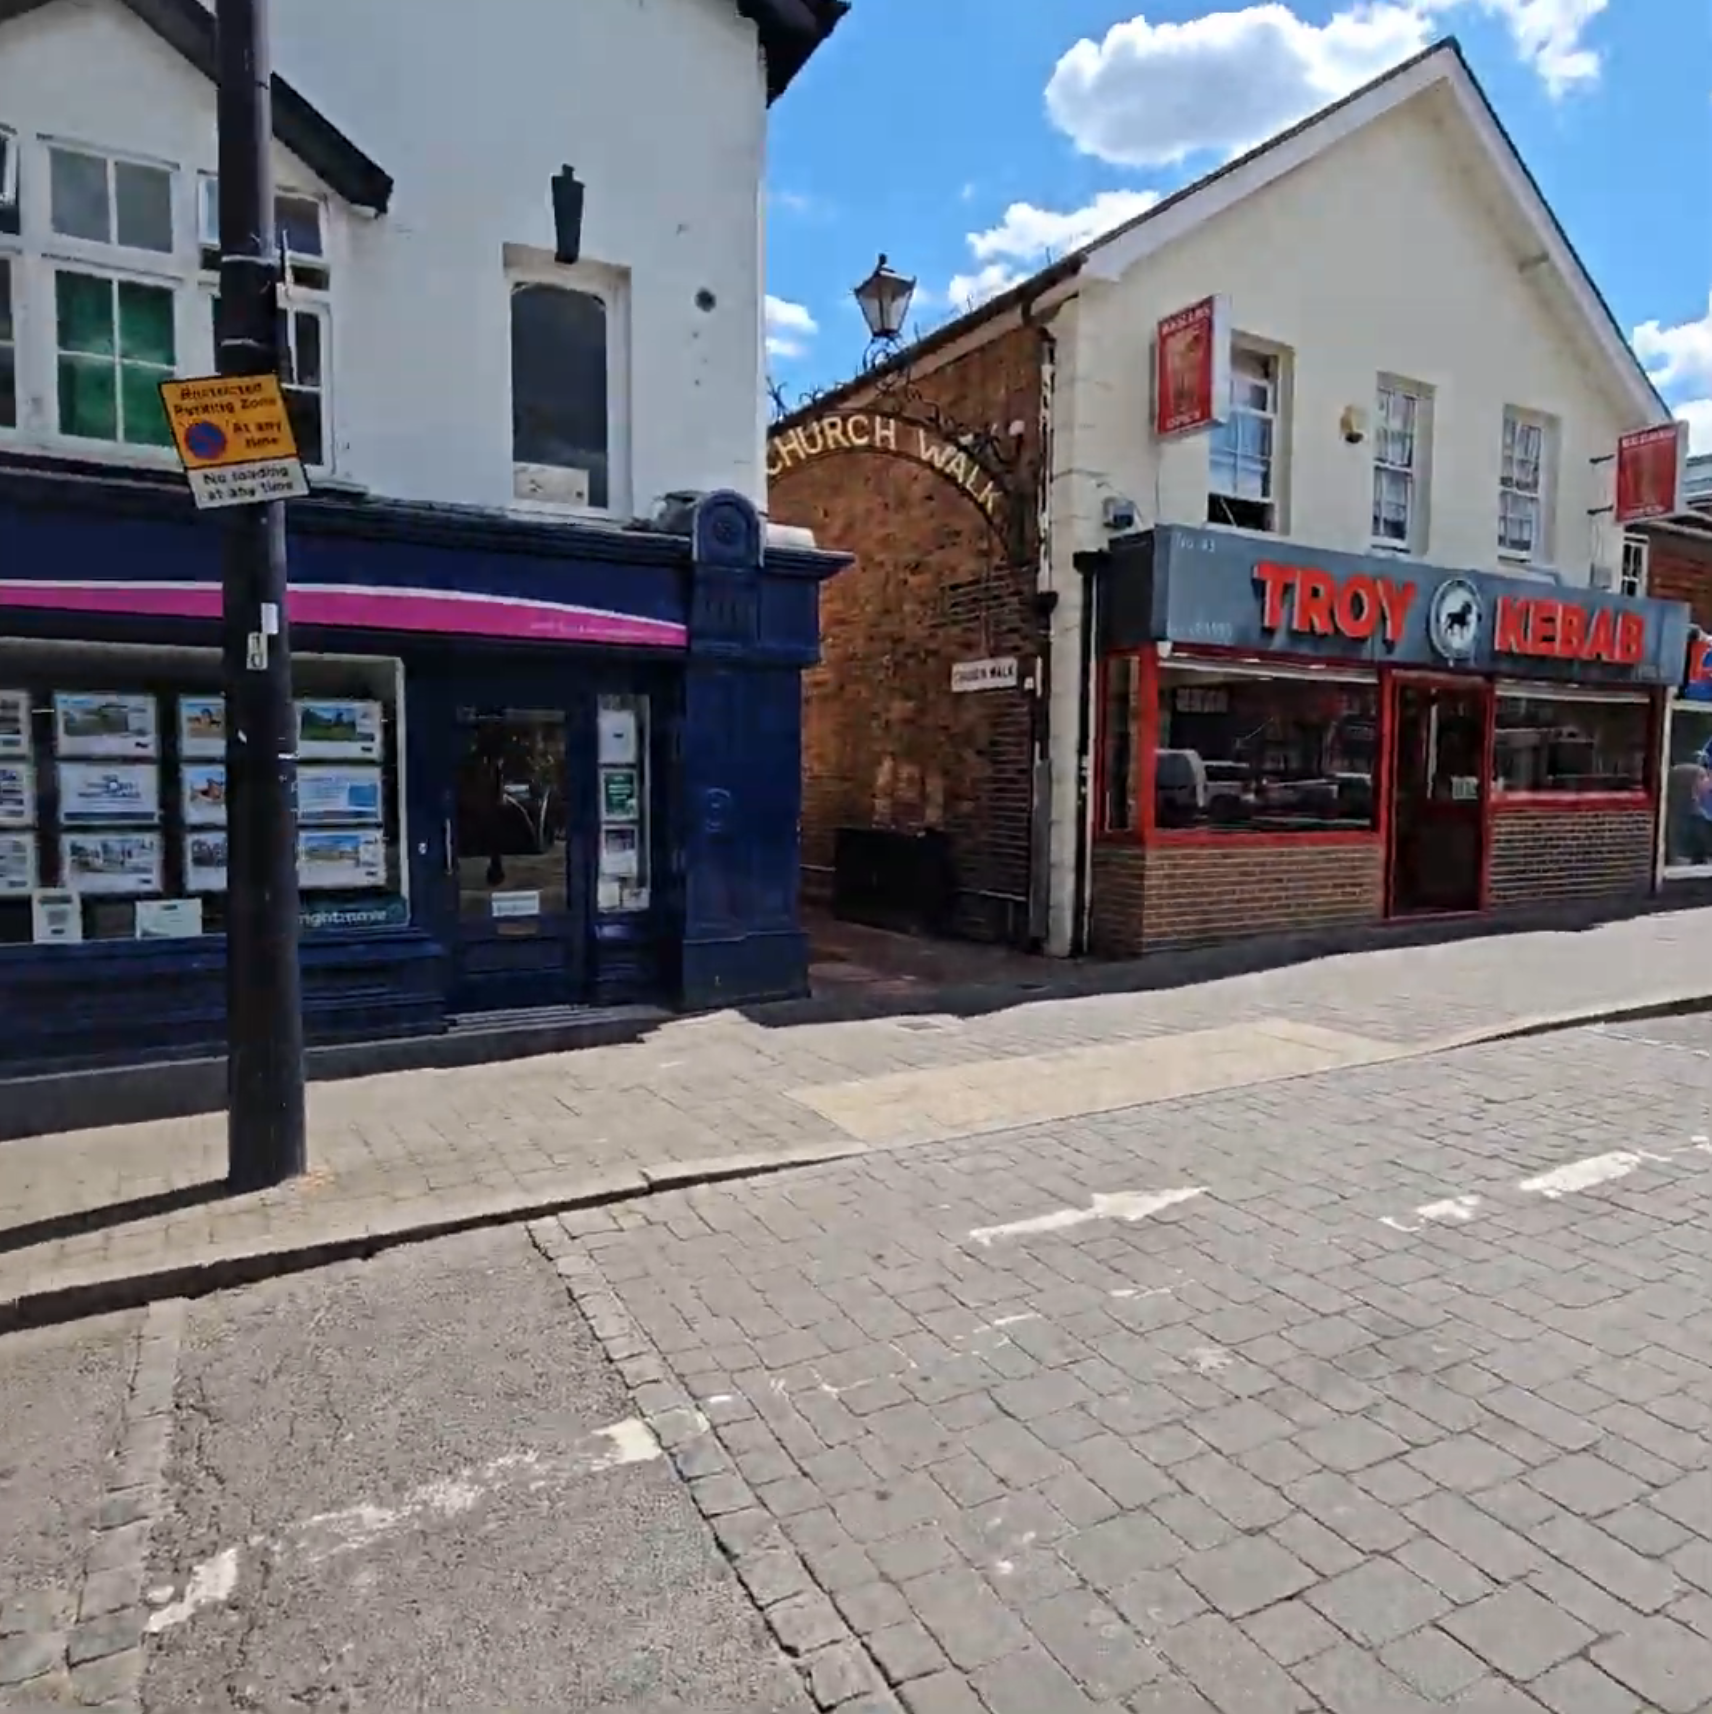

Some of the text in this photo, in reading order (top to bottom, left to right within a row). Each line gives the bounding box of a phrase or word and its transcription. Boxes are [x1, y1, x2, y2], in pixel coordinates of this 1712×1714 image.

[917, 428, 1003, 514] WALK
[1252, 559, 1646, 664] TROY KEBAB
